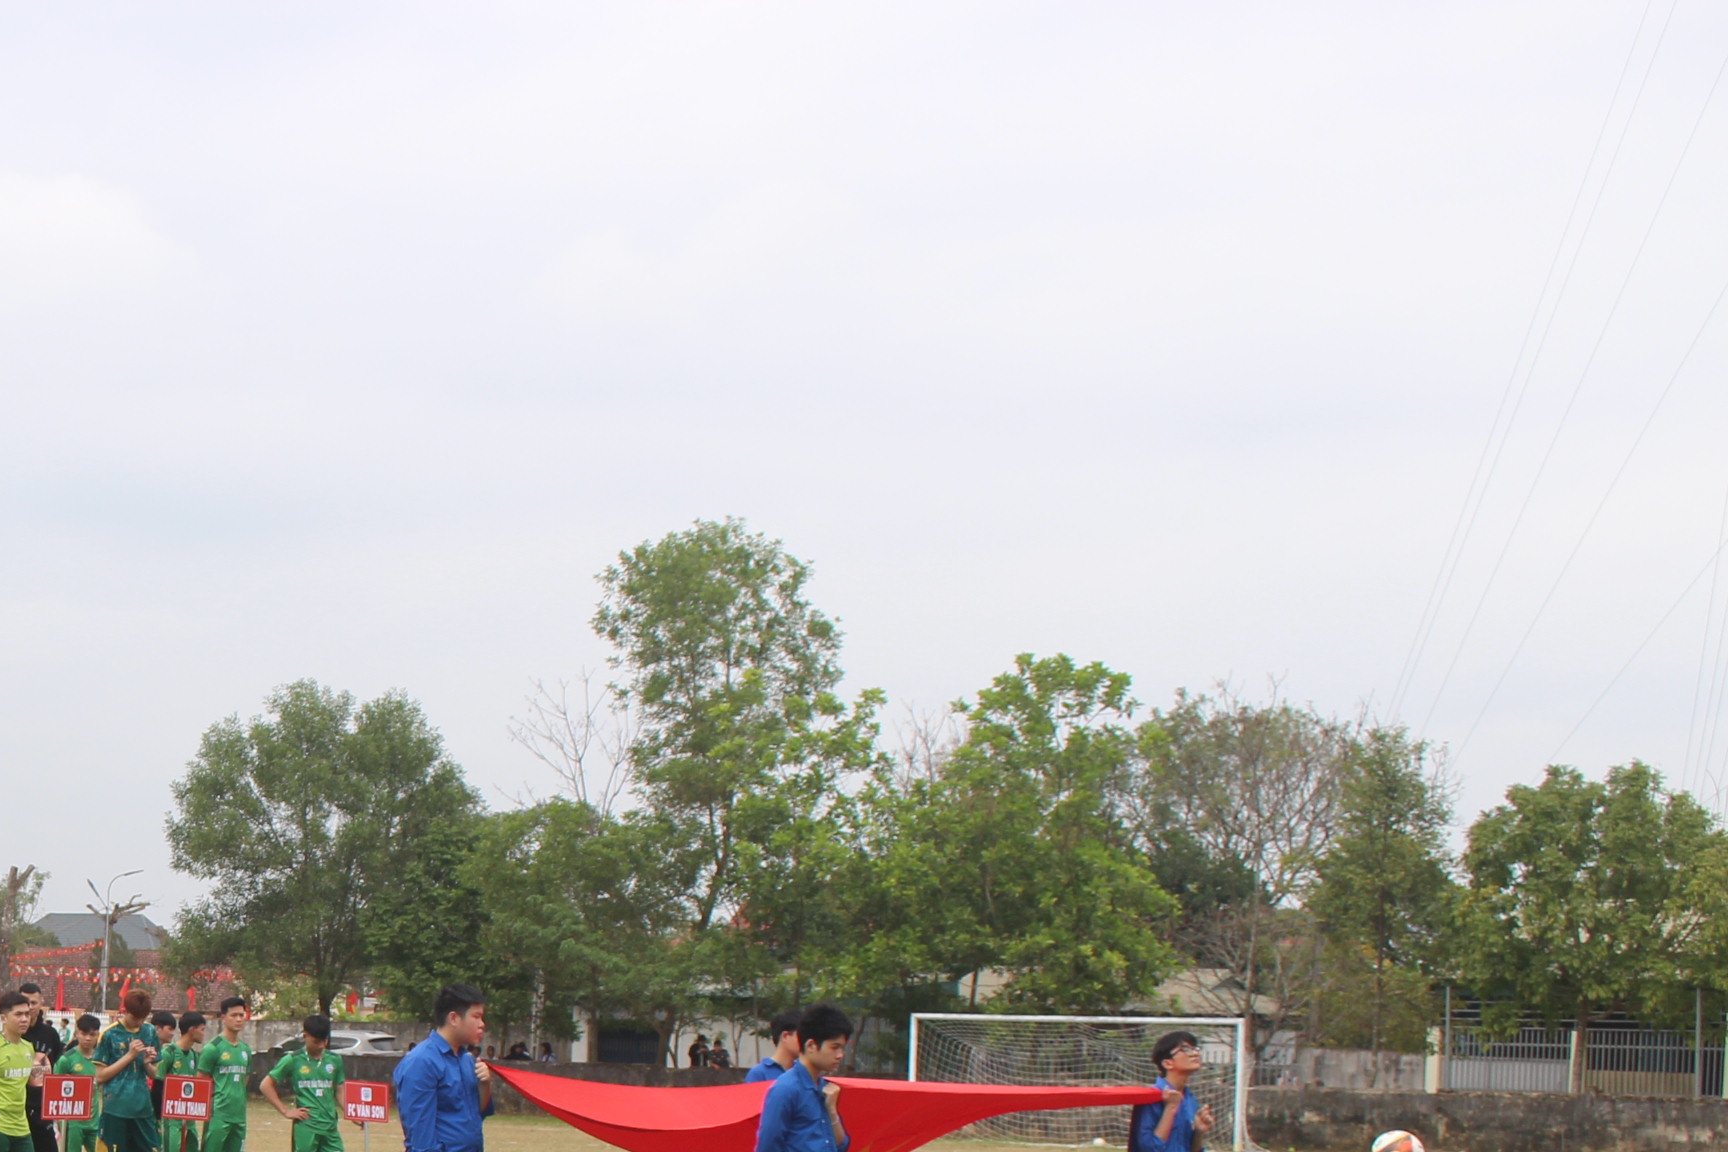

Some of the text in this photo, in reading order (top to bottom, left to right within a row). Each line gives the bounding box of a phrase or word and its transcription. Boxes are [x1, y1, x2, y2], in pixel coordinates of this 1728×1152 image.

[49, 1098, 84, 1115] FC TÂN AN
[165, 1099, 173, 1114] FC
[187, 1101, 207, 1117] THANH
[347, 1103, 355, 1117] FC
